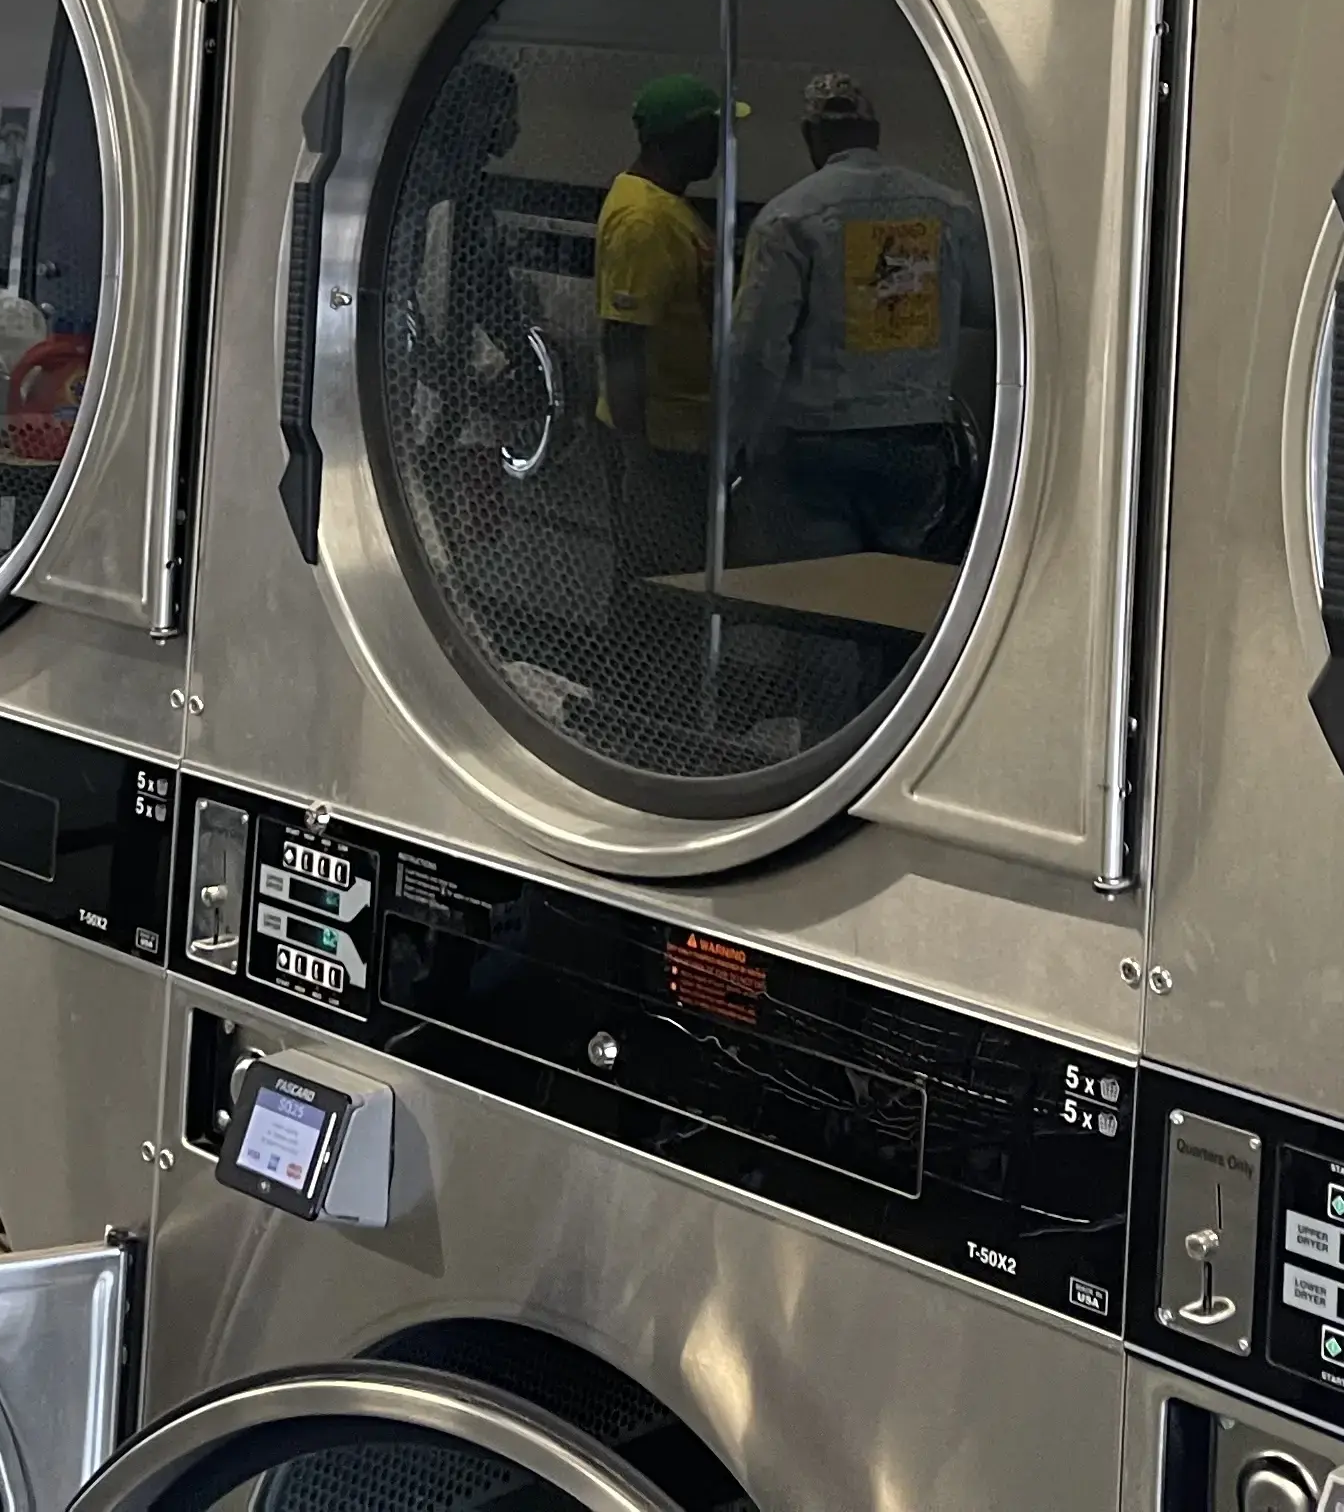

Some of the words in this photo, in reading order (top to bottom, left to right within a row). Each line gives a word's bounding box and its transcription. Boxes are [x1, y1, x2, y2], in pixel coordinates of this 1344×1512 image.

[136, 771, 146, 790] 5
[135, 796, 145, 815] 5
[1065, 1064, 1079, 1089] 5
[1084, 1077, 1095, 1096] x
[1063, 1098, 1078, 1124] 5
[1081, 1111, 1093, 1130] x
[966, 1240, 1017, 1276] T-50X2
[1076, 1291, 1100, 1309] USA
